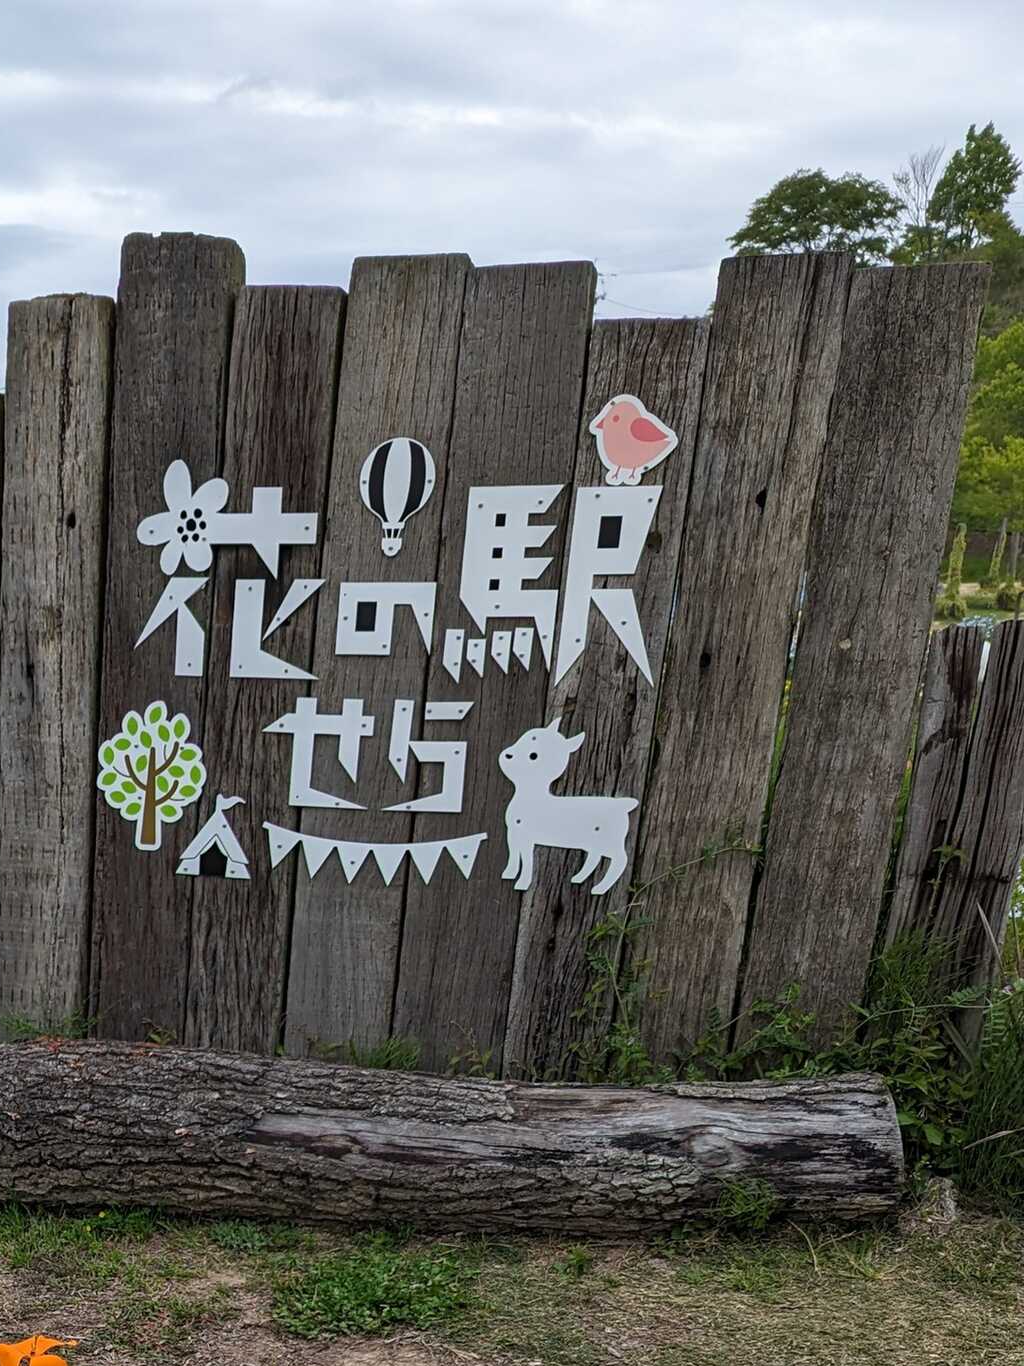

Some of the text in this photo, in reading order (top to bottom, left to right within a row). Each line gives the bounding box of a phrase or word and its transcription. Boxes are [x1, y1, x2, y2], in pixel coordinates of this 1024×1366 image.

[134, 459, 663, 687] 花の駅
[262, 698, 475, 812] せら
